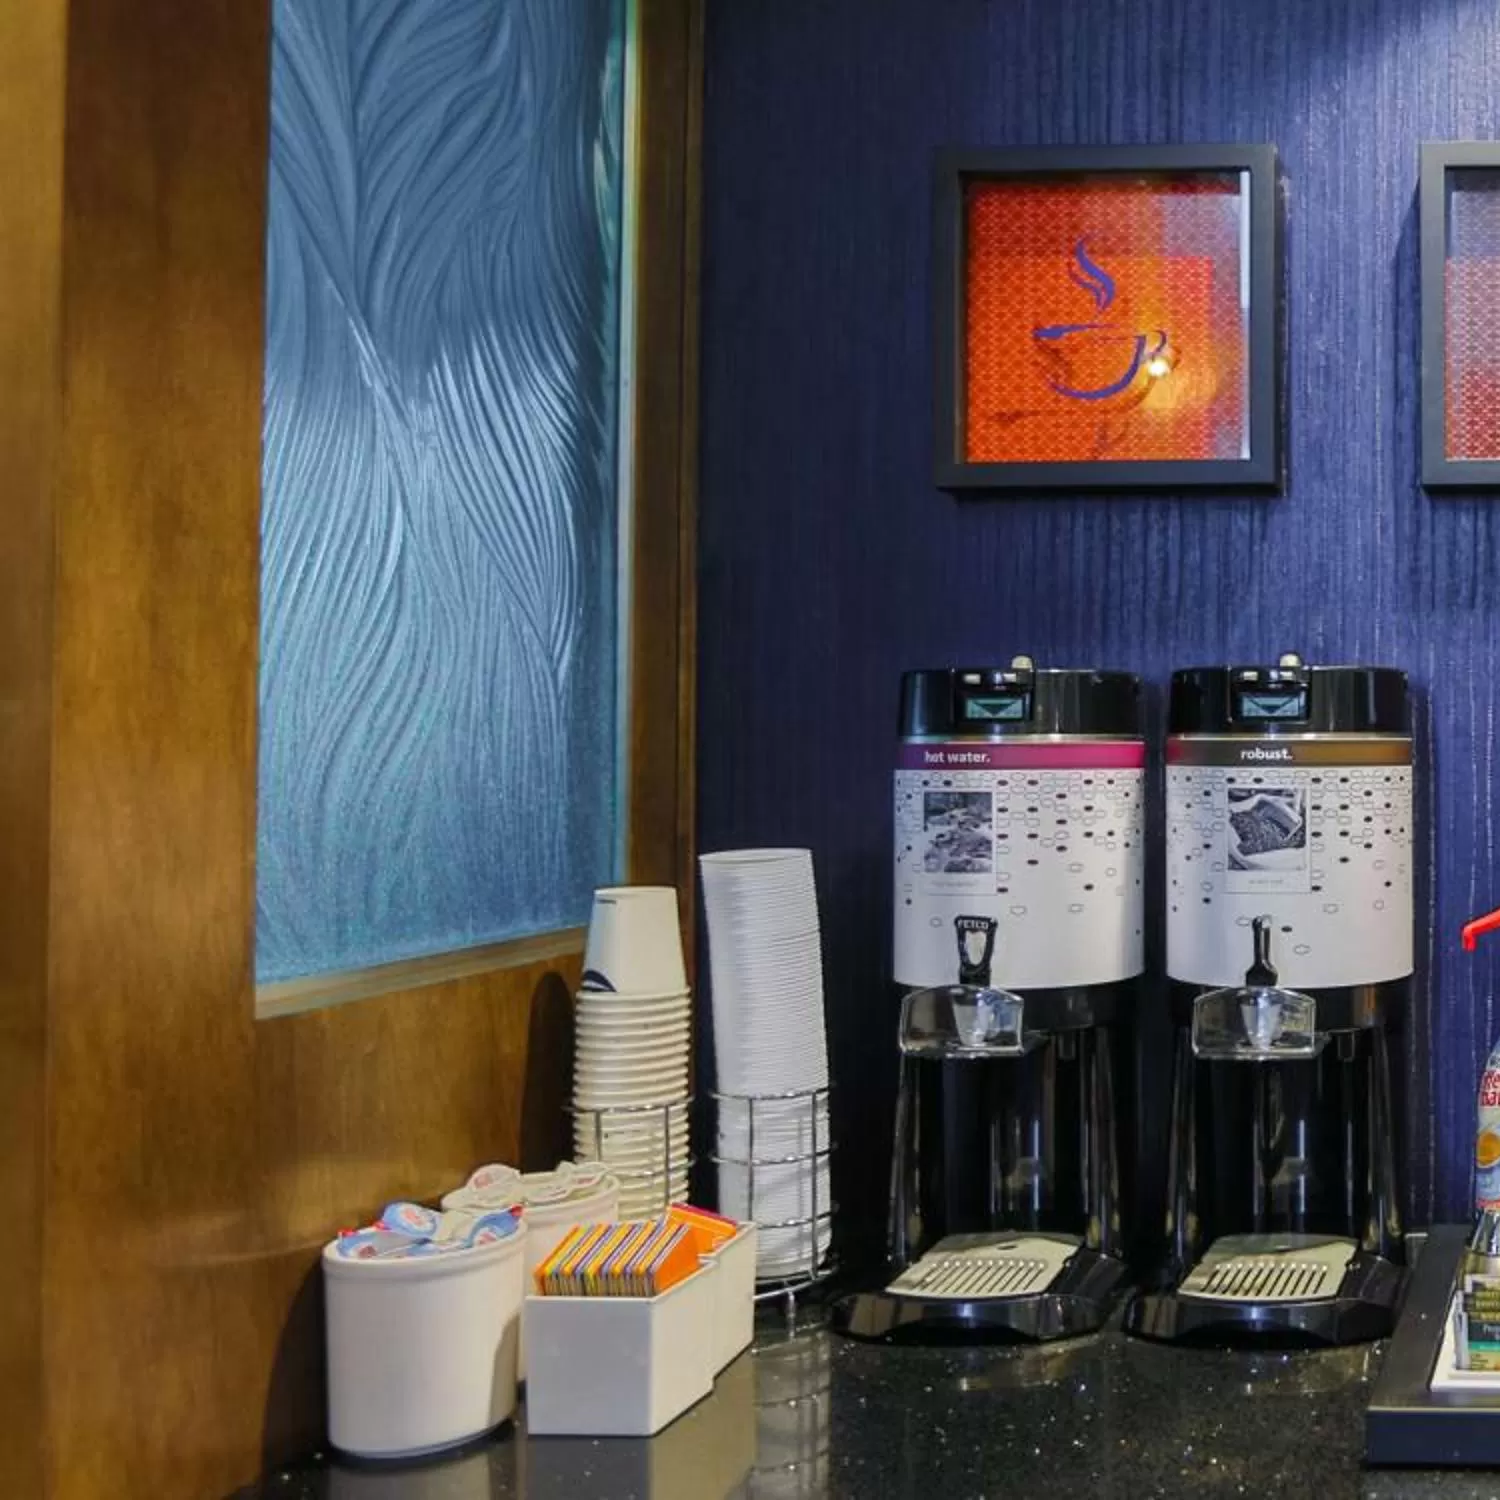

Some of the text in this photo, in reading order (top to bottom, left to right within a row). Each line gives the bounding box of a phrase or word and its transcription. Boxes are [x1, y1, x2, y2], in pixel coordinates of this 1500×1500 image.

[924, 750, 992, 764] hot water.
[1240, 747, 1294, 760] robust.
